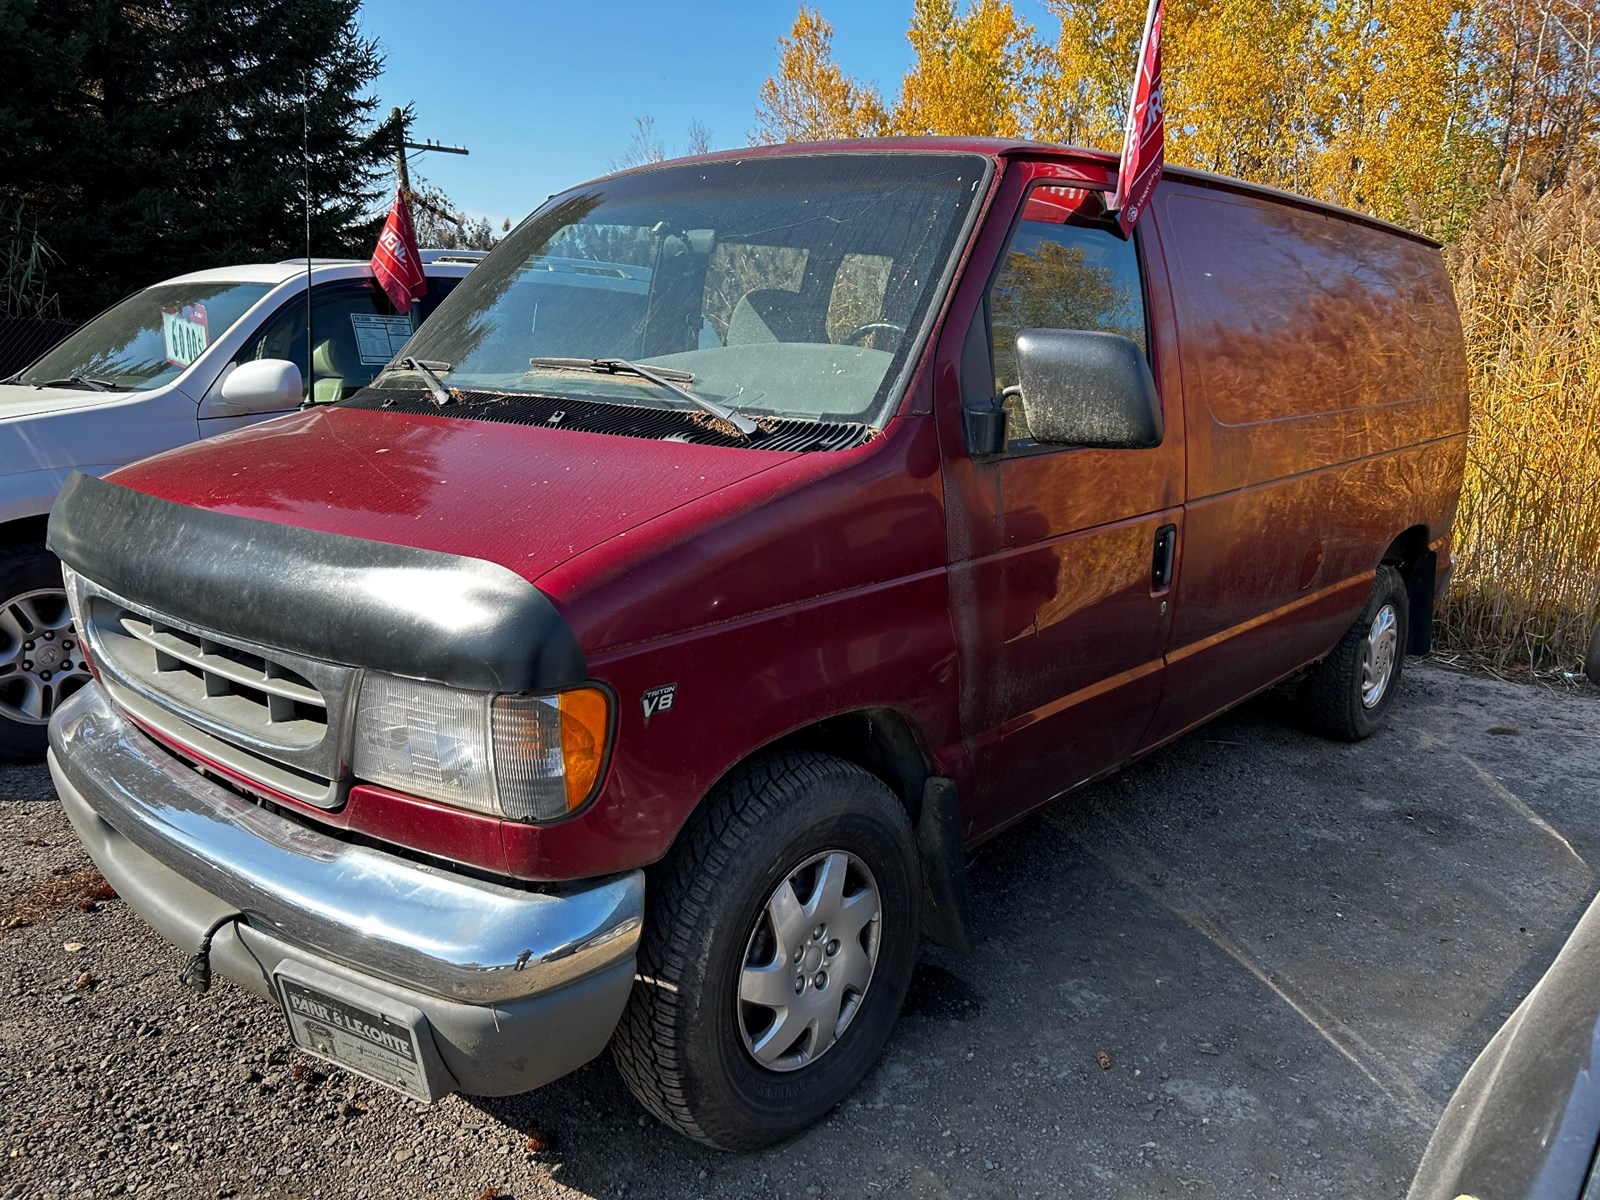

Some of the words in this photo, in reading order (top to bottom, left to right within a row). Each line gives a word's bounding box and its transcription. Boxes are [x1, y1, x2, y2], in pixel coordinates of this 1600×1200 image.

[646, 685, 676, 698] TRITON
[642, 693, 673, 718] V8
[289, 994, 330, 1020] PARR
[333, 1011, 343, 1026] &
[345, 1015, 410, 1054] LECONTE
